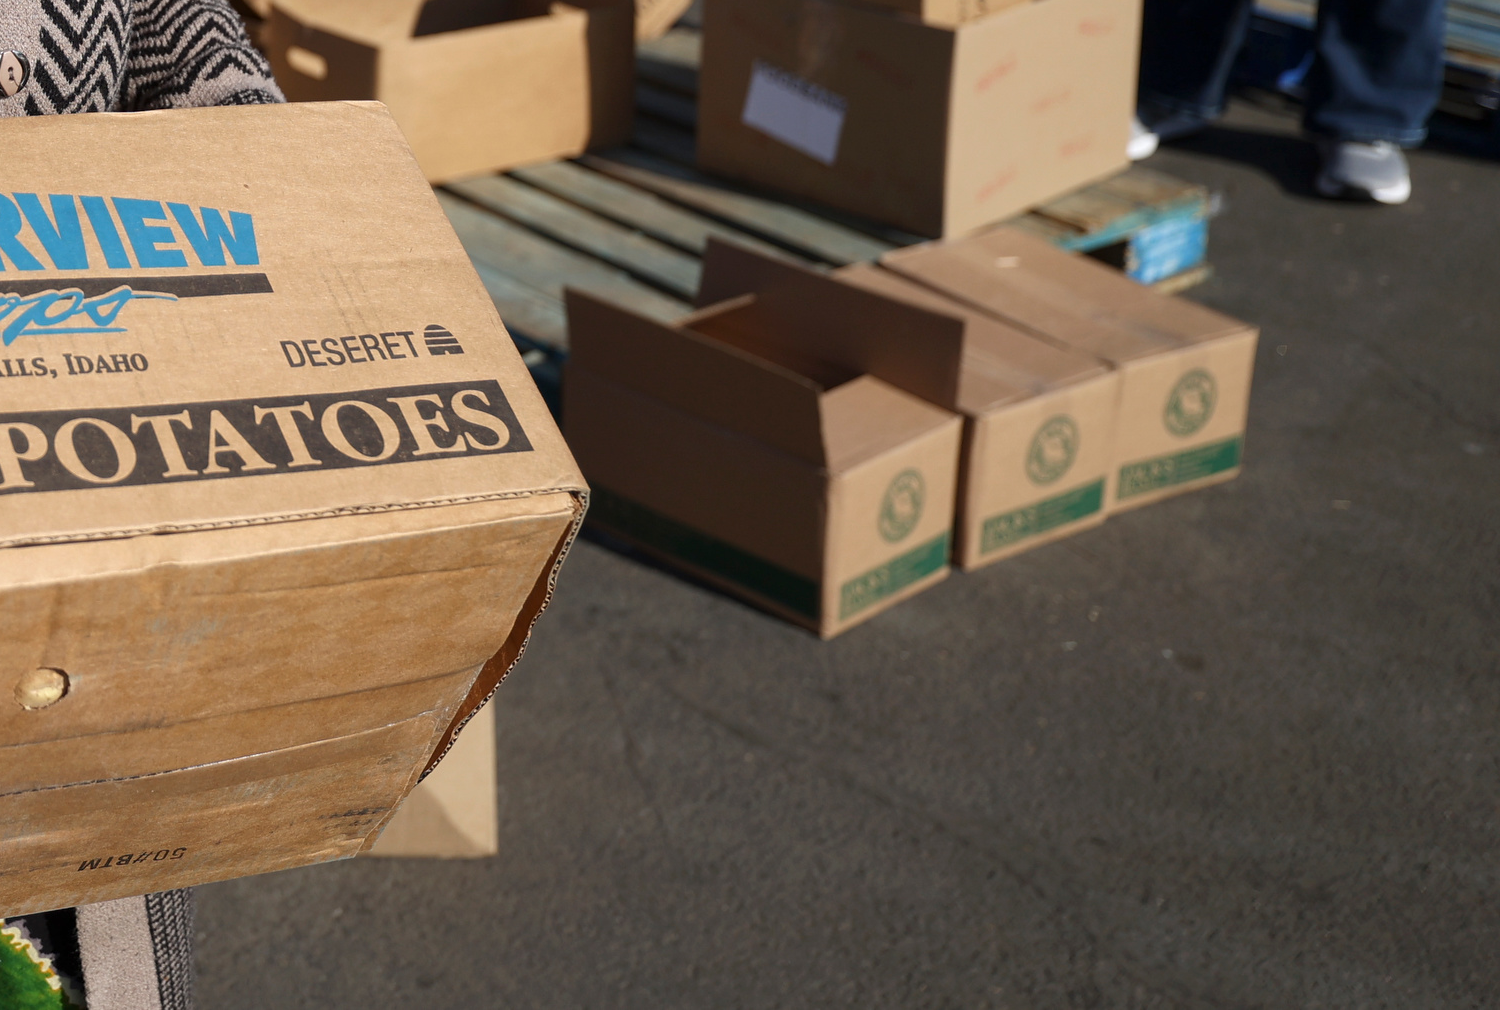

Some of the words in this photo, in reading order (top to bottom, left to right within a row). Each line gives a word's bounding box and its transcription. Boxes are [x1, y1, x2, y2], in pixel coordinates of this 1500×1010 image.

[279, 330, 419, 368] DESERET
[62, 352, 149, 375] IDAHO
[77, 847, 188, 872] 50#BTM
